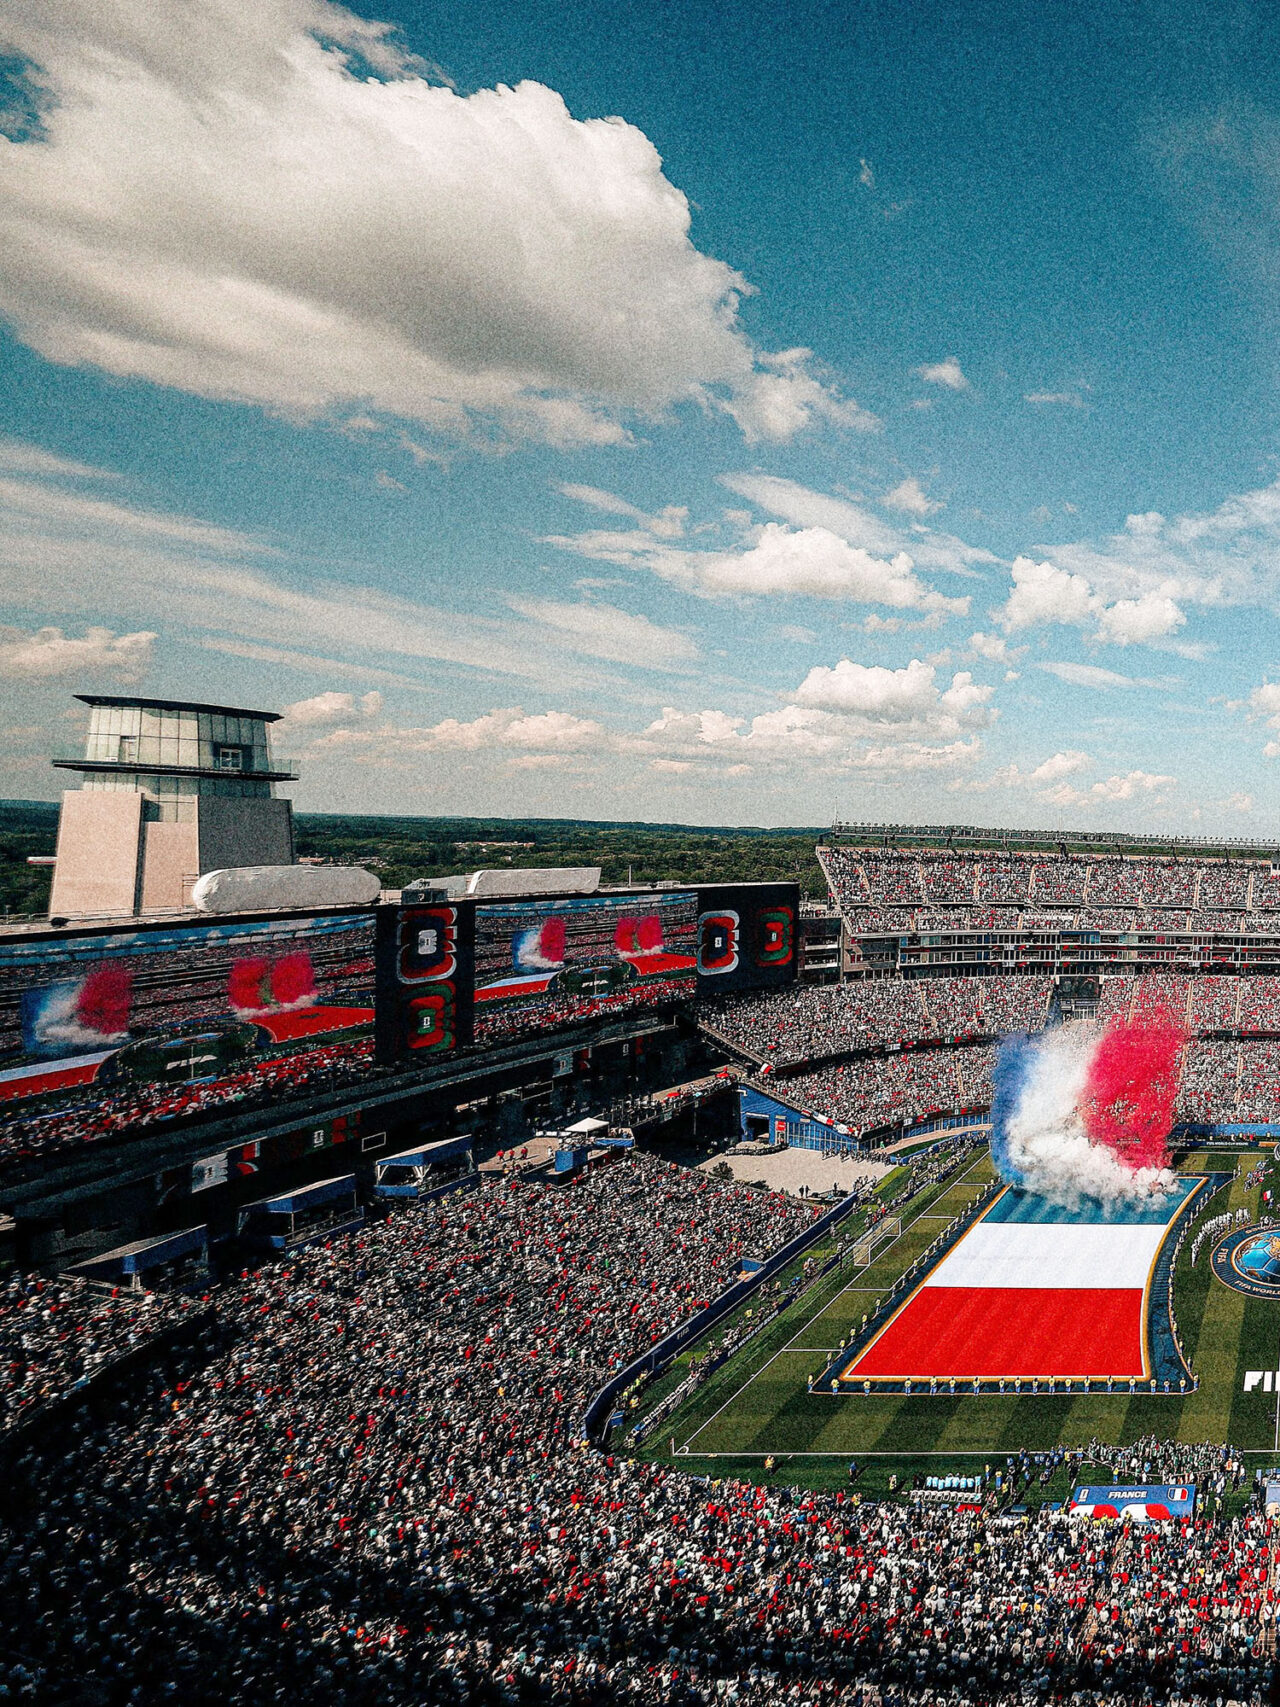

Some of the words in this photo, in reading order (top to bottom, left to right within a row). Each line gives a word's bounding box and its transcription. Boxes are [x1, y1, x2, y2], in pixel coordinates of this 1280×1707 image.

[1217, 1248, 1229, 1264] FIFA
[1235, 1280, 1251, 1290] FIFA
[677, 1326, 690, 1340] FIFA
[1108, 1491, 1147, 1499] FRANCE
